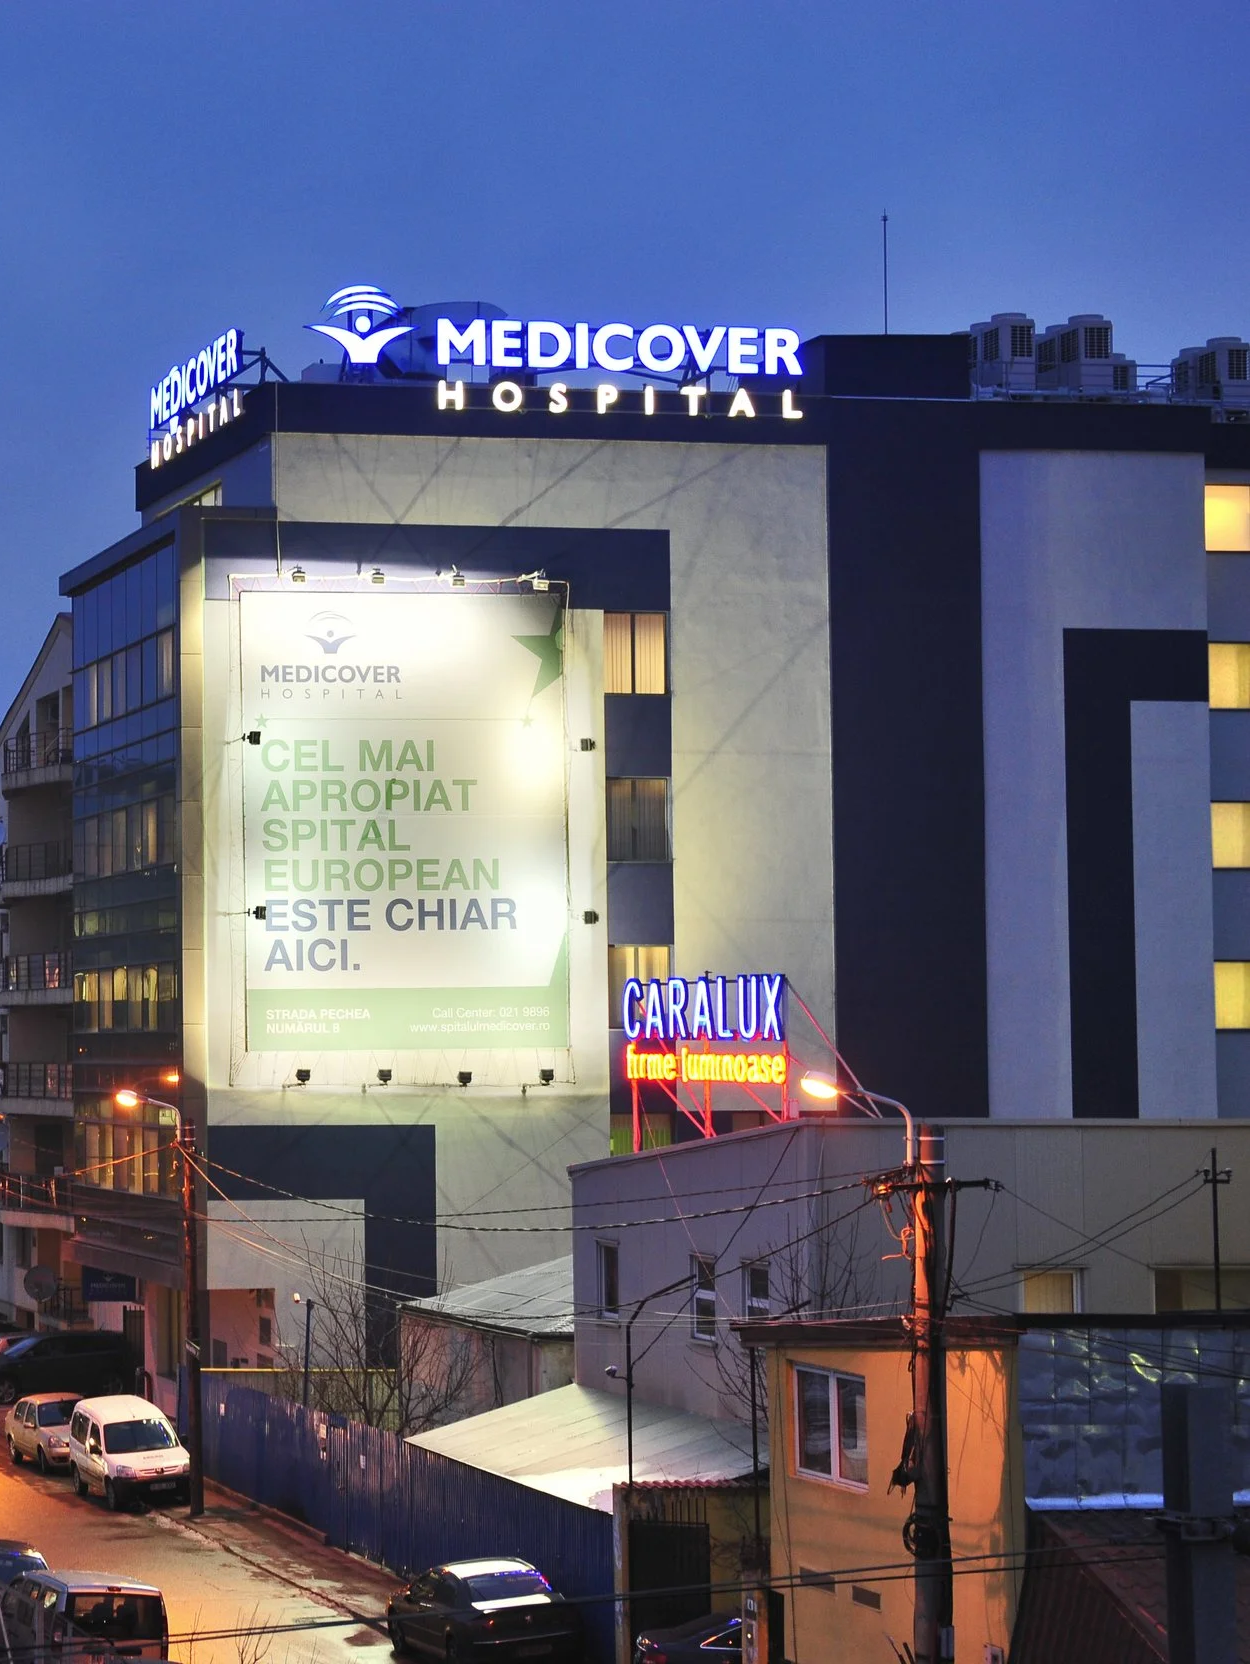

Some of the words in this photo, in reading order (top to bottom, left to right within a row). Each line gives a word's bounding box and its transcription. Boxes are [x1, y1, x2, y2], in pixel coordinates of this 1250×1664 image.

[437, 317, 803, 376] MEDICOVER
[150, 328, 240, 430] MEDICOVER
[436, 380, 804, 419] HOSPITAL
[150, 388, 241, 470] HOSPITAL
[260, 665, 402, 684] MEDICOVER
[260, 688, 402, 700] HOSPITAL
[261, 739, 344, 772] CEL
[359, 739, 435, 772] MAI
[260, 779, 478, 813] APROPIAT
[262, 819, 411, 852] SPITAL
[263, 858, 500, 892] EUROPEAN
[264, 899, 371, 932] ESTE
[385, 898, 517, 932] CHIAR
[264, 938, 361, 972] AICI.
[266, 1009, 317, 1020] STRADA
[320, 1008, 371, 1020] PECHEA
[432, 1007, 453, 1018] Call
[456, 1007, 495, 1018] Center:
[499, 1006, 518, 1018] 021
[522, 1006, 550, 1017] 9896
[623, 974, 785, 1042] CARALUX
[266, 1020, 331, 1034] NUMĂRUL
[332, 1023, 340, 1033] 8
[409, 1020, 551, 1033] www.spitalulmedicover.ro
[626, 1044, 677, 1081] firme
[681, 1047, 787, 1085] luminoase
